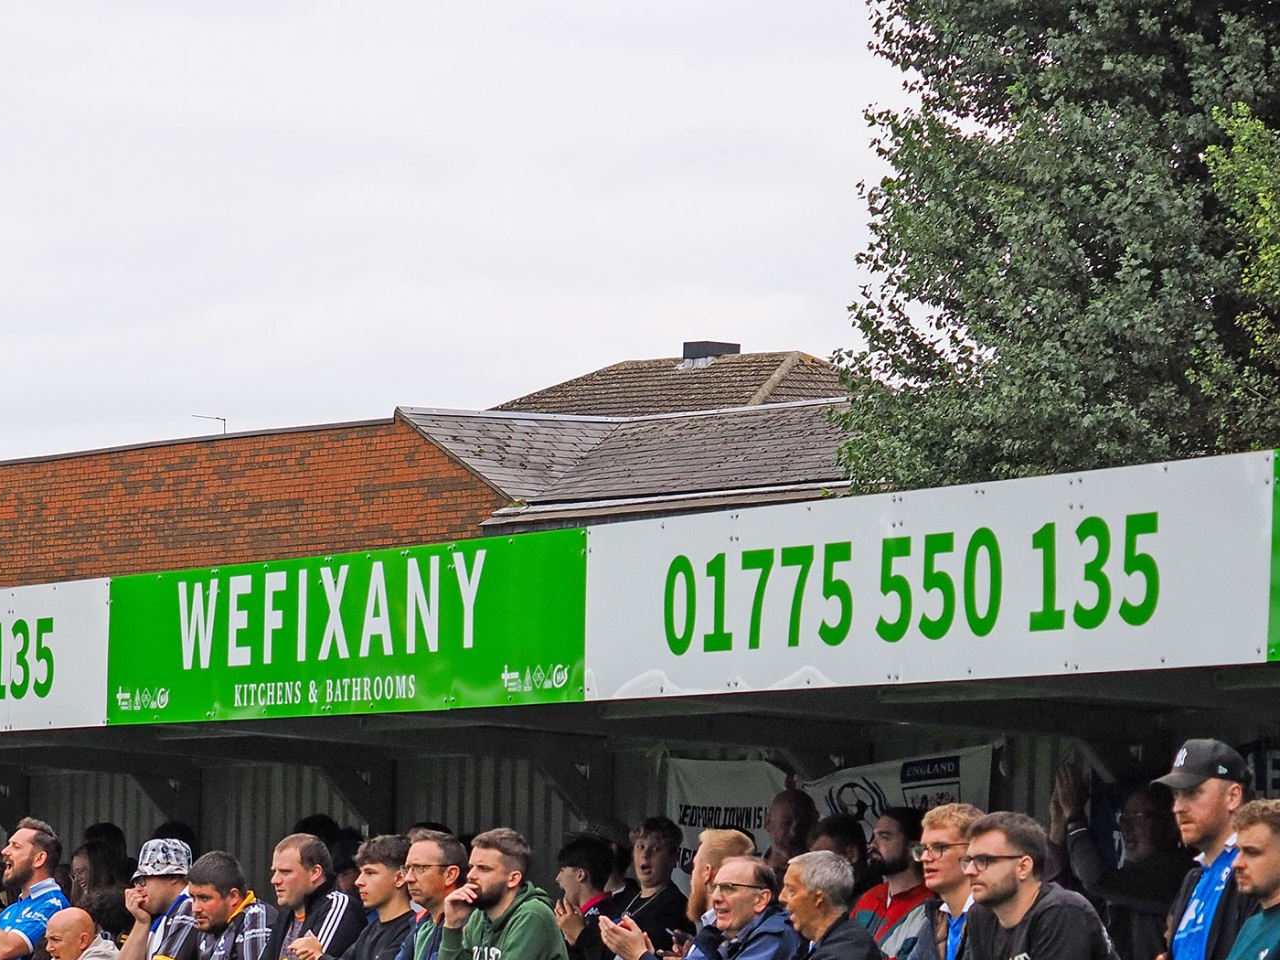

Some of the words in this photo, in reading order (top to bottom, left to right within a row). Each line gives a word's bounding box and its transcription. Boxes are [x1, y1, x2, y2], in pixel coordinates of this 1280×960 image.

[663, 540, 854, 657] 01775
[875, 526, 1002, 643] 550
[1028, 511, 1160, 632] 135
[178, 549, 487, 670] WEFIXANY
[234, 680, 303, 707] KITCHENS
[308, 681, 318, 703] &
[326, 675, 416, 702] BATHROOMS
[906, 761, 955, 778] ENGLAND
[725, 806, 751, 829] TOWN
